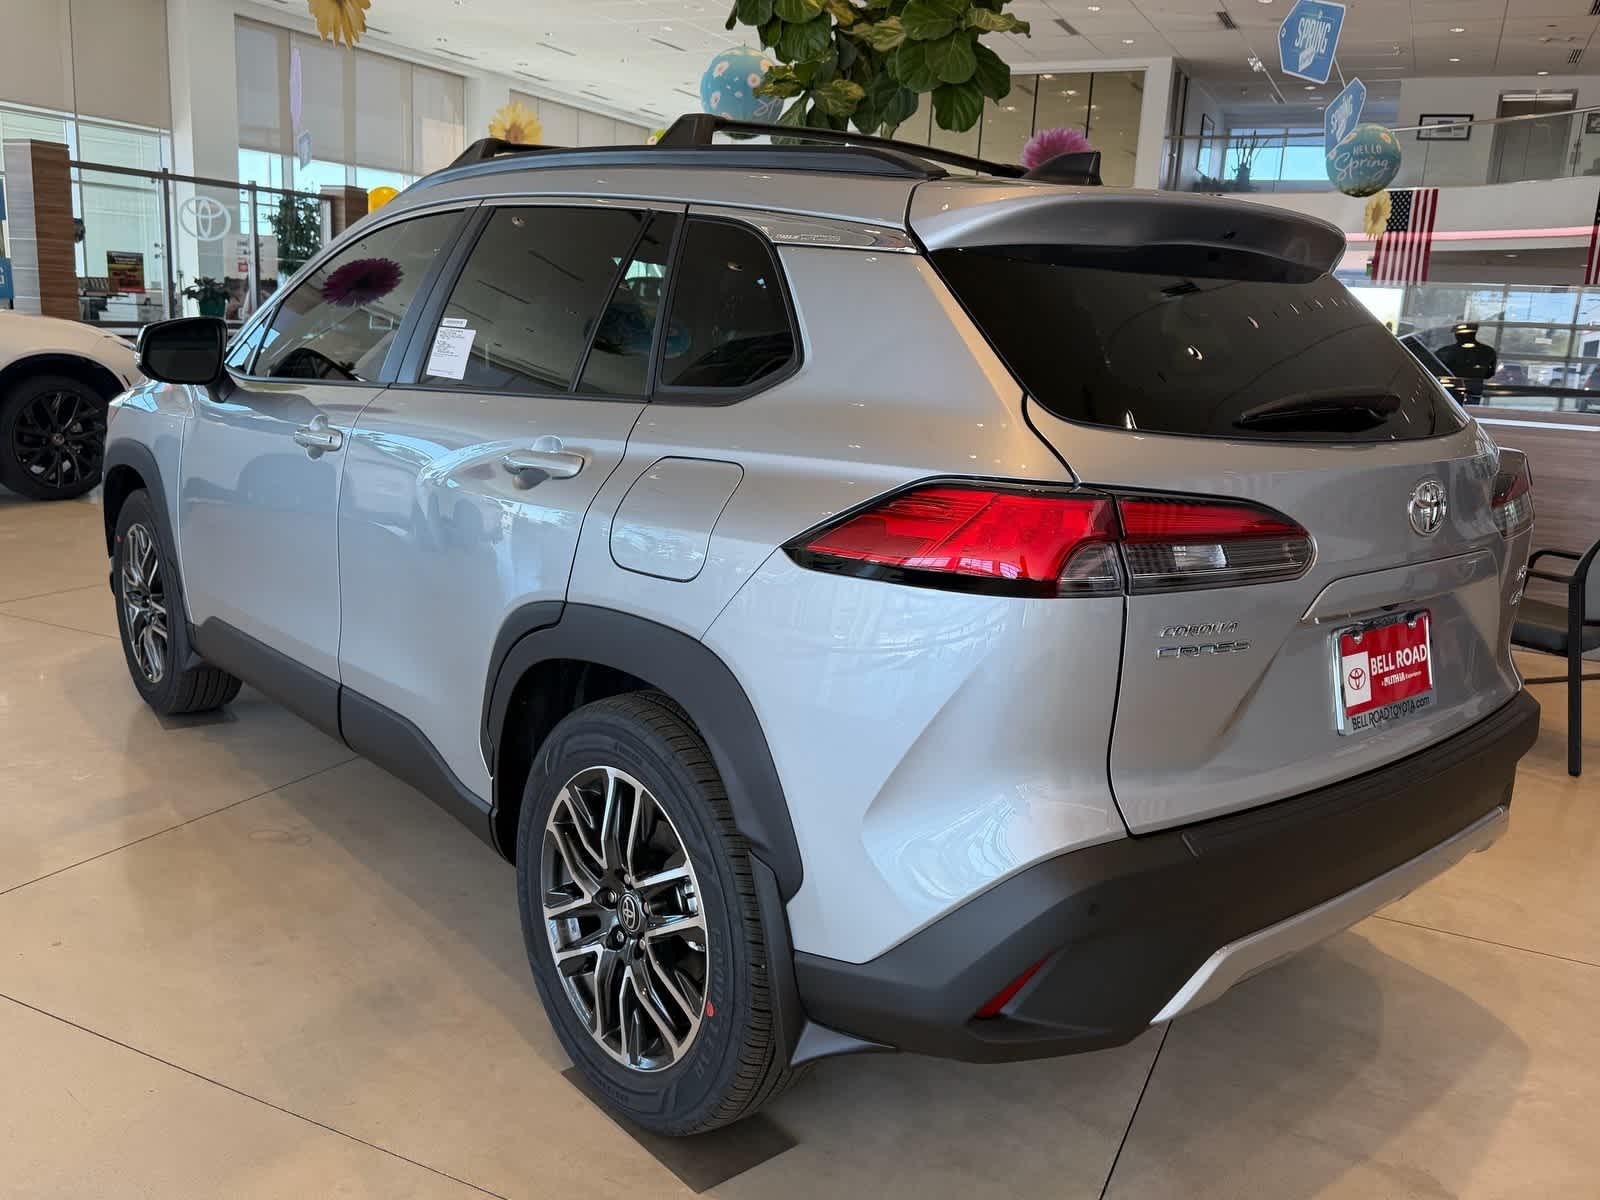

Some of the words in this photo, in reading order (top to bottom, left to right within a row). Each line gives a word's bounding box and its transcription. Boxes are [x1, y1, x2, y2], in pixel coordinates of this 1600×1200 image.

[1295, 17, 1331, 54] SPRING
[1353, 145, 1382, 154] HELLO
[1334, 151, 1389, 181] Spring
[1157, 641, 1250, 659] CROSS
[1370, 653, 1395, 676] BELL
[1396, 644, 1427, 668] ROAD
